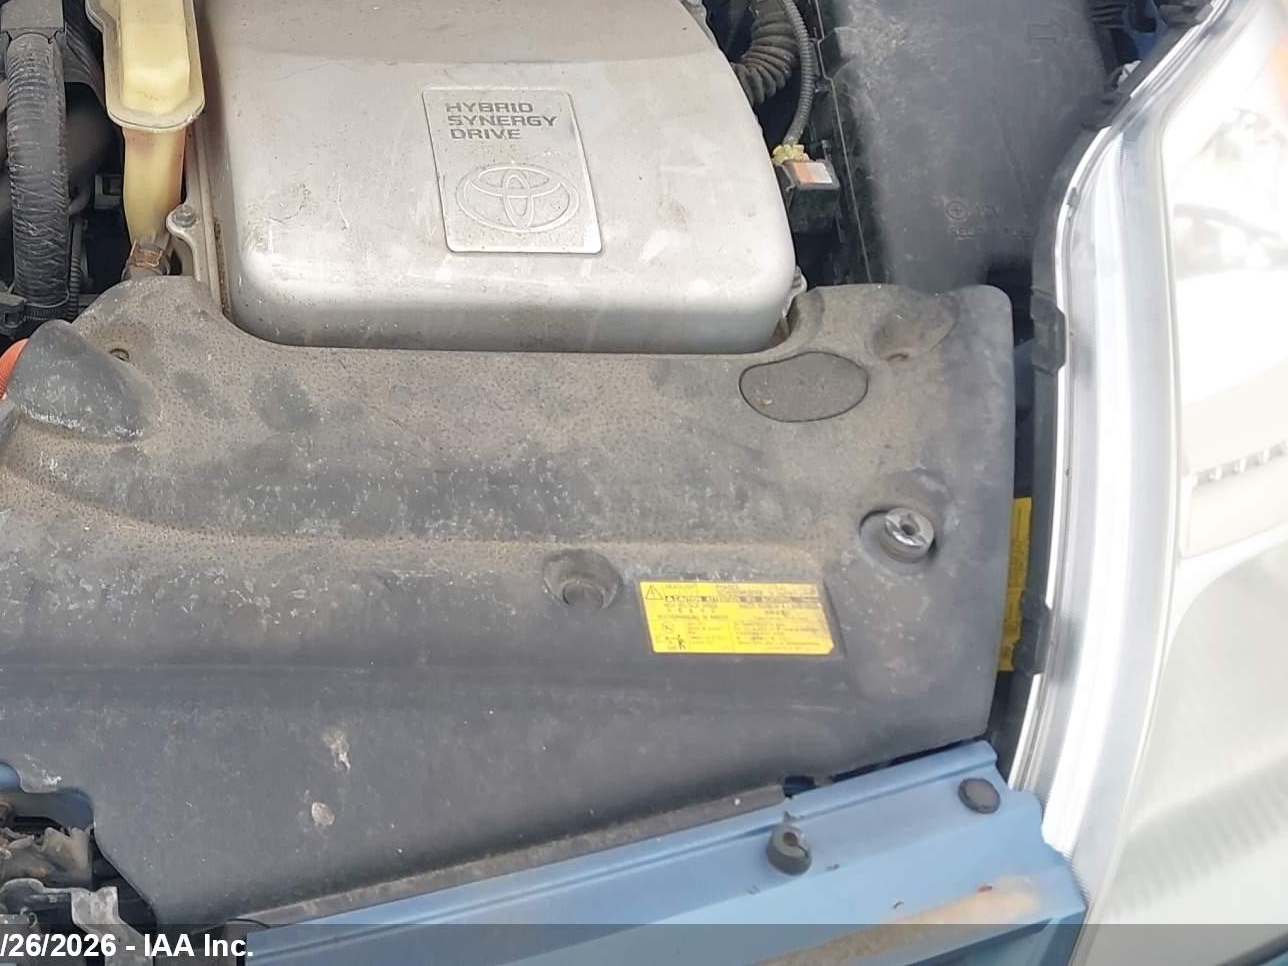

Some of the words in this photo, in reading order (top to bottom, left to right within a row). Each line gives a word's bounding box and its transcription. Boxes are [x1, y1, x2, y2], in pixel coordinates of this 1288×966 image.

[445, 102, 534, 113] HYBRID
[447, 115, 558, 127] SYNERGY
[450, 128, 522, 140] DRIVE
